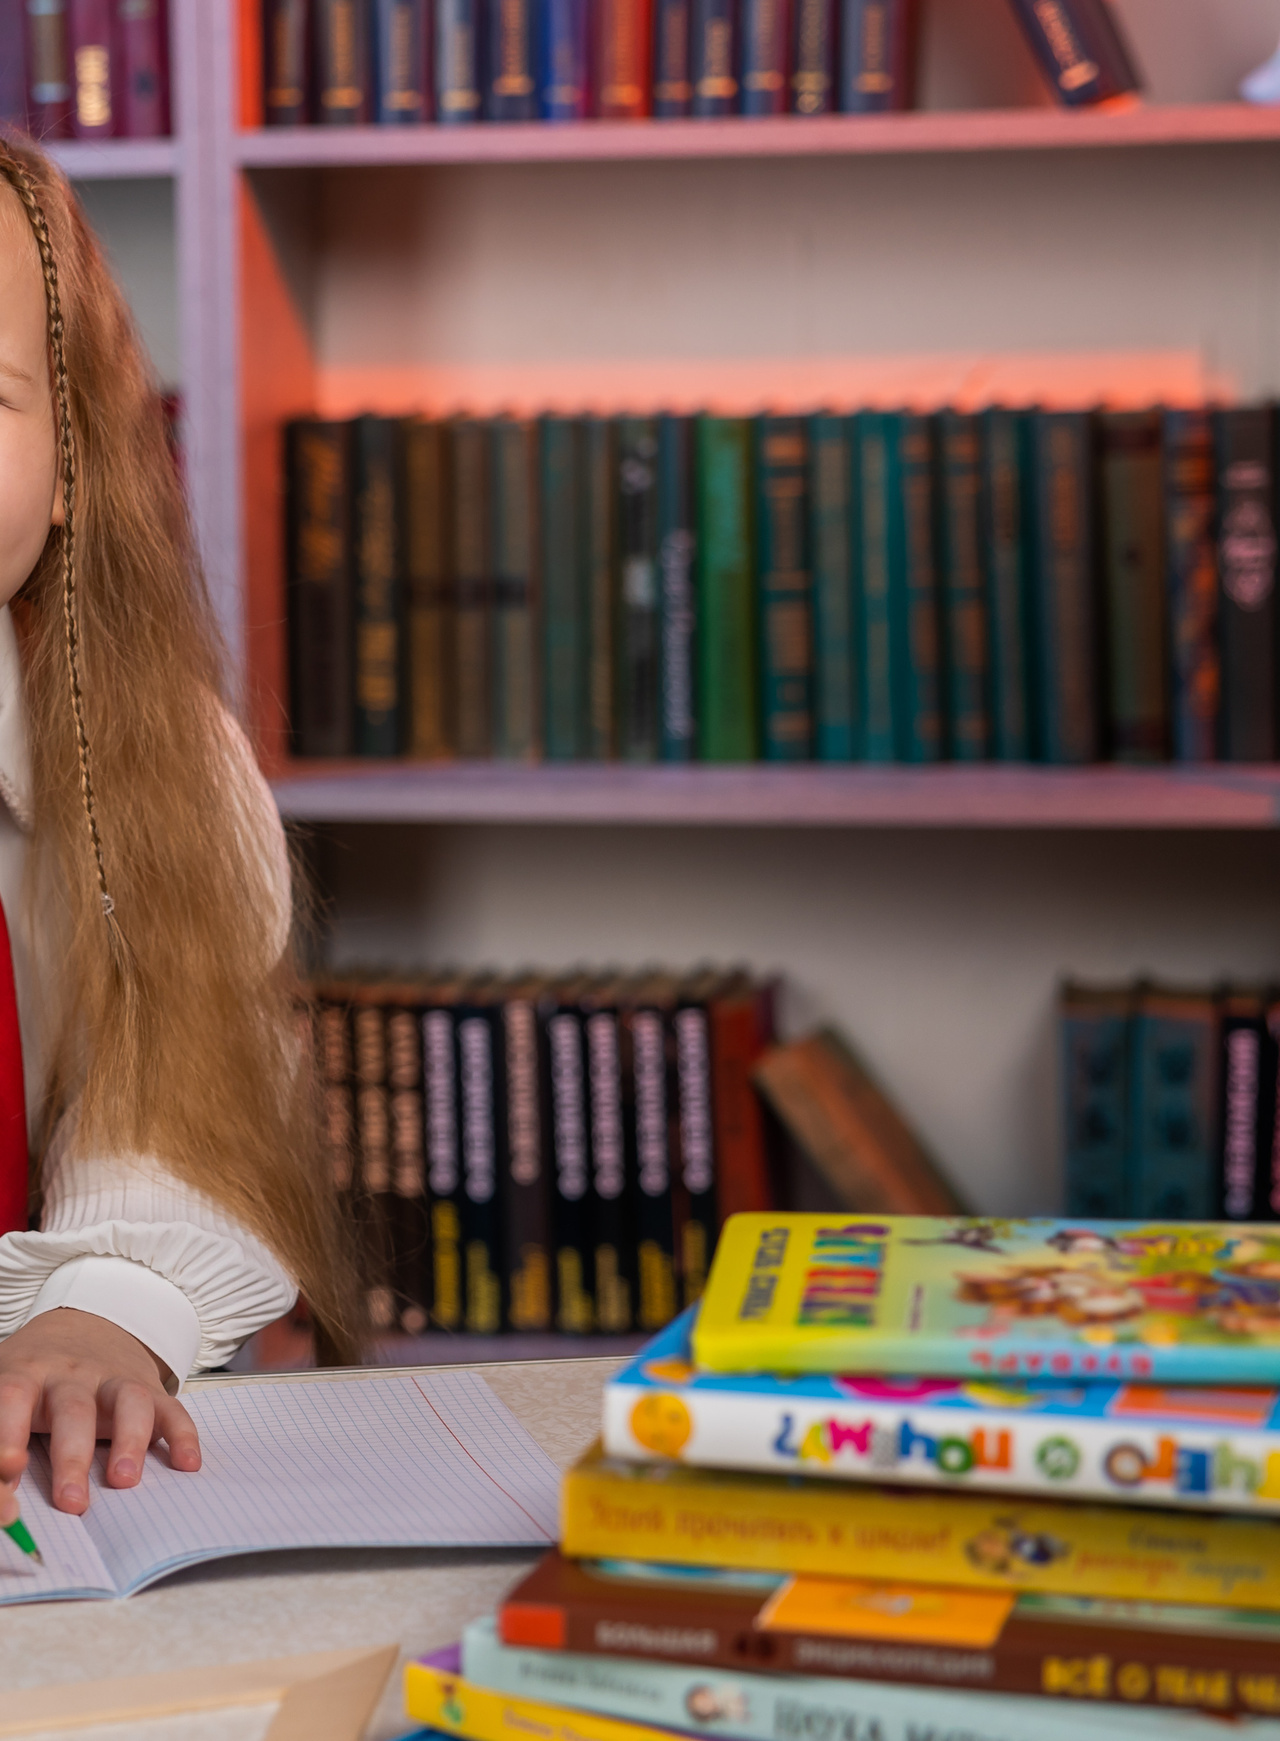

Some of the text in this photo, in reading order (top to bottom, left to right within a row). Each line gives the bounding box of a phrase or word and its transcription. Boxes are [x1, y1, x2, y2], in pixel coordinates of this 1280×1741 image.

[594, 1622, 994, 1678] БОЛЬШАЯ ЭНЦИКЛОПЕДИЯ
[1042, 1655, 1110, 1696] ВСЁ
[1117, 1664, 1150, 1699] О
[1156, 1666, 1230, 1706] ТЕЛЕ
